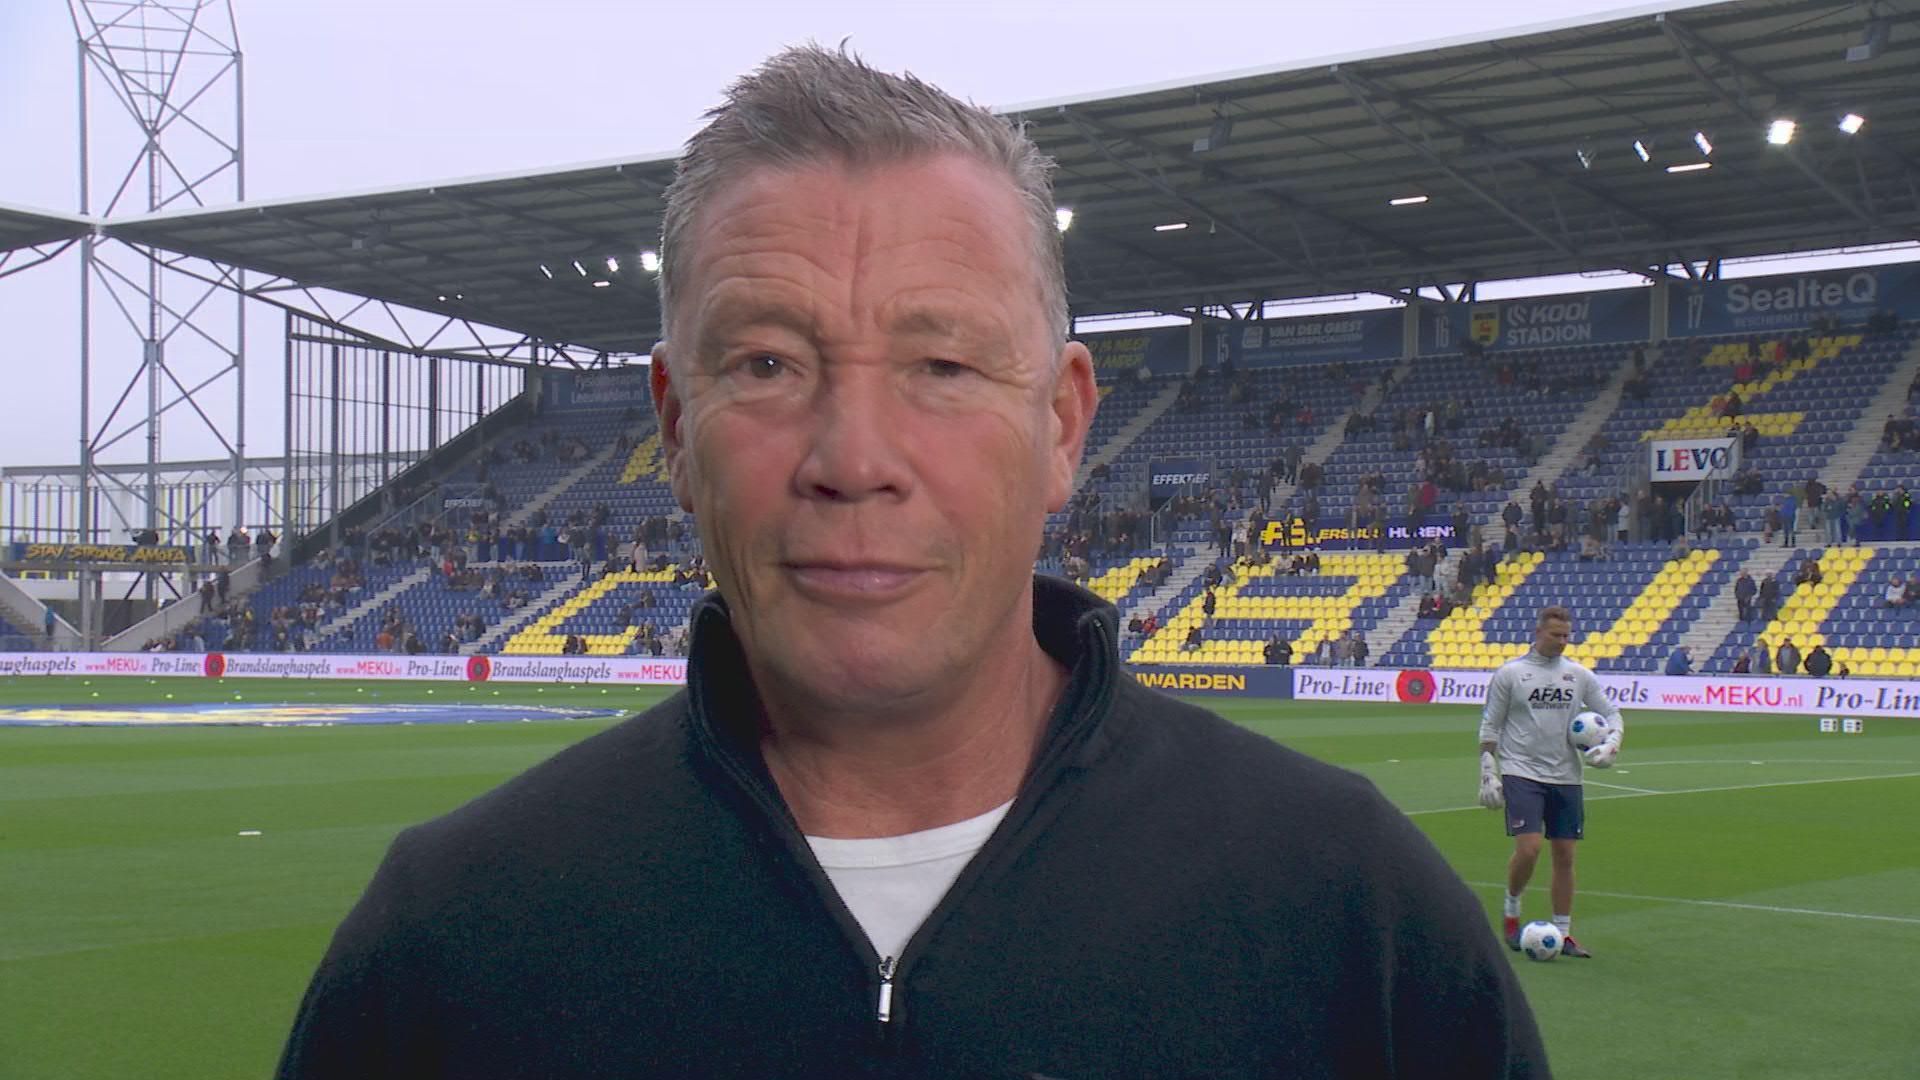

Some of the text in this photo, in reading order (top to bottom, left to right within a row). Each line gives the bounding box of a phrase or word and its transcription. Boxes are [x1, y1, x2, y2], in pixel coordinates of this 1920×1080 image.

[1727, 272, 1877, 313] SealteQ
[1269, 326, 1295, 338] VAN
[1296, 323, 1321, 336] DER
[1434, 315, 1449, 348] 16
[1507, 323, 1591, 346] STADION
[1656, 447, 1729, 472] LEVO
[25, 545, 63, 559] STAY
[69, 546, 125, 561] STRONG
[152, 657, 198, 673] Pro-Line
[227, 657, 331, 678] Brandslanghaspels
[407, 660, 459, 676] Pro-Line
[492, 661, 611, 683] Brandslanghaspels
[1299, 675, 1385, 697] Pro-Line
[1528, 688, 1574, 702] AFAS
[1662, 685, 1803, 706] www.MEKU.nl
